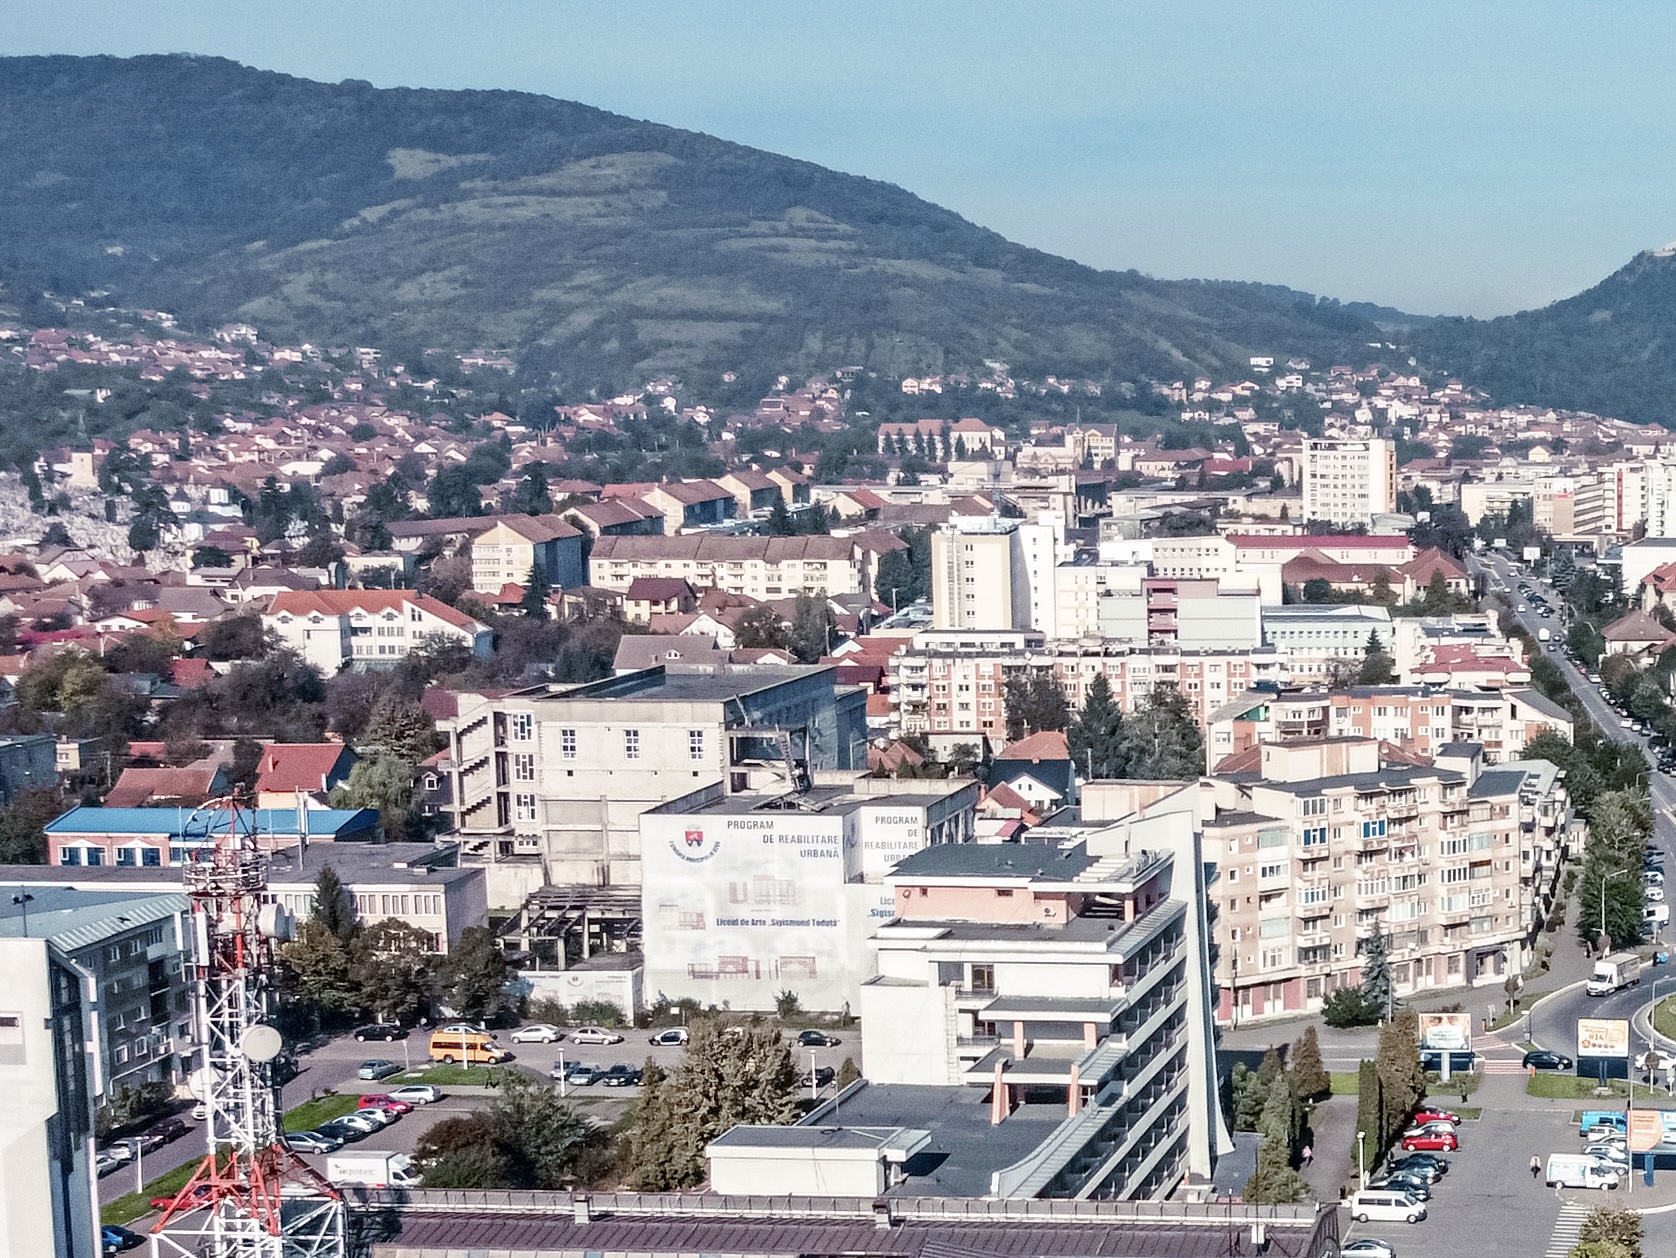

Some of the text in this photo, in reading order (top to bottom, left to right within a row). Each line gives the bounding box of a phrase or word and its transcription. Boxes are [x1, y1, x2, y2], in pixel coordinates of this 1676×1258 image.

[727, 820, 774, 829] PROGRAM
[875, 816, 918, 824] PROGRAM
[908, 829, 918, 837] DE
[763, 834, 839, 844] DE REABILITARE
[864, 841, 919, 850] REABILITARE
[800, 847, 839, 858] URBANĂ
